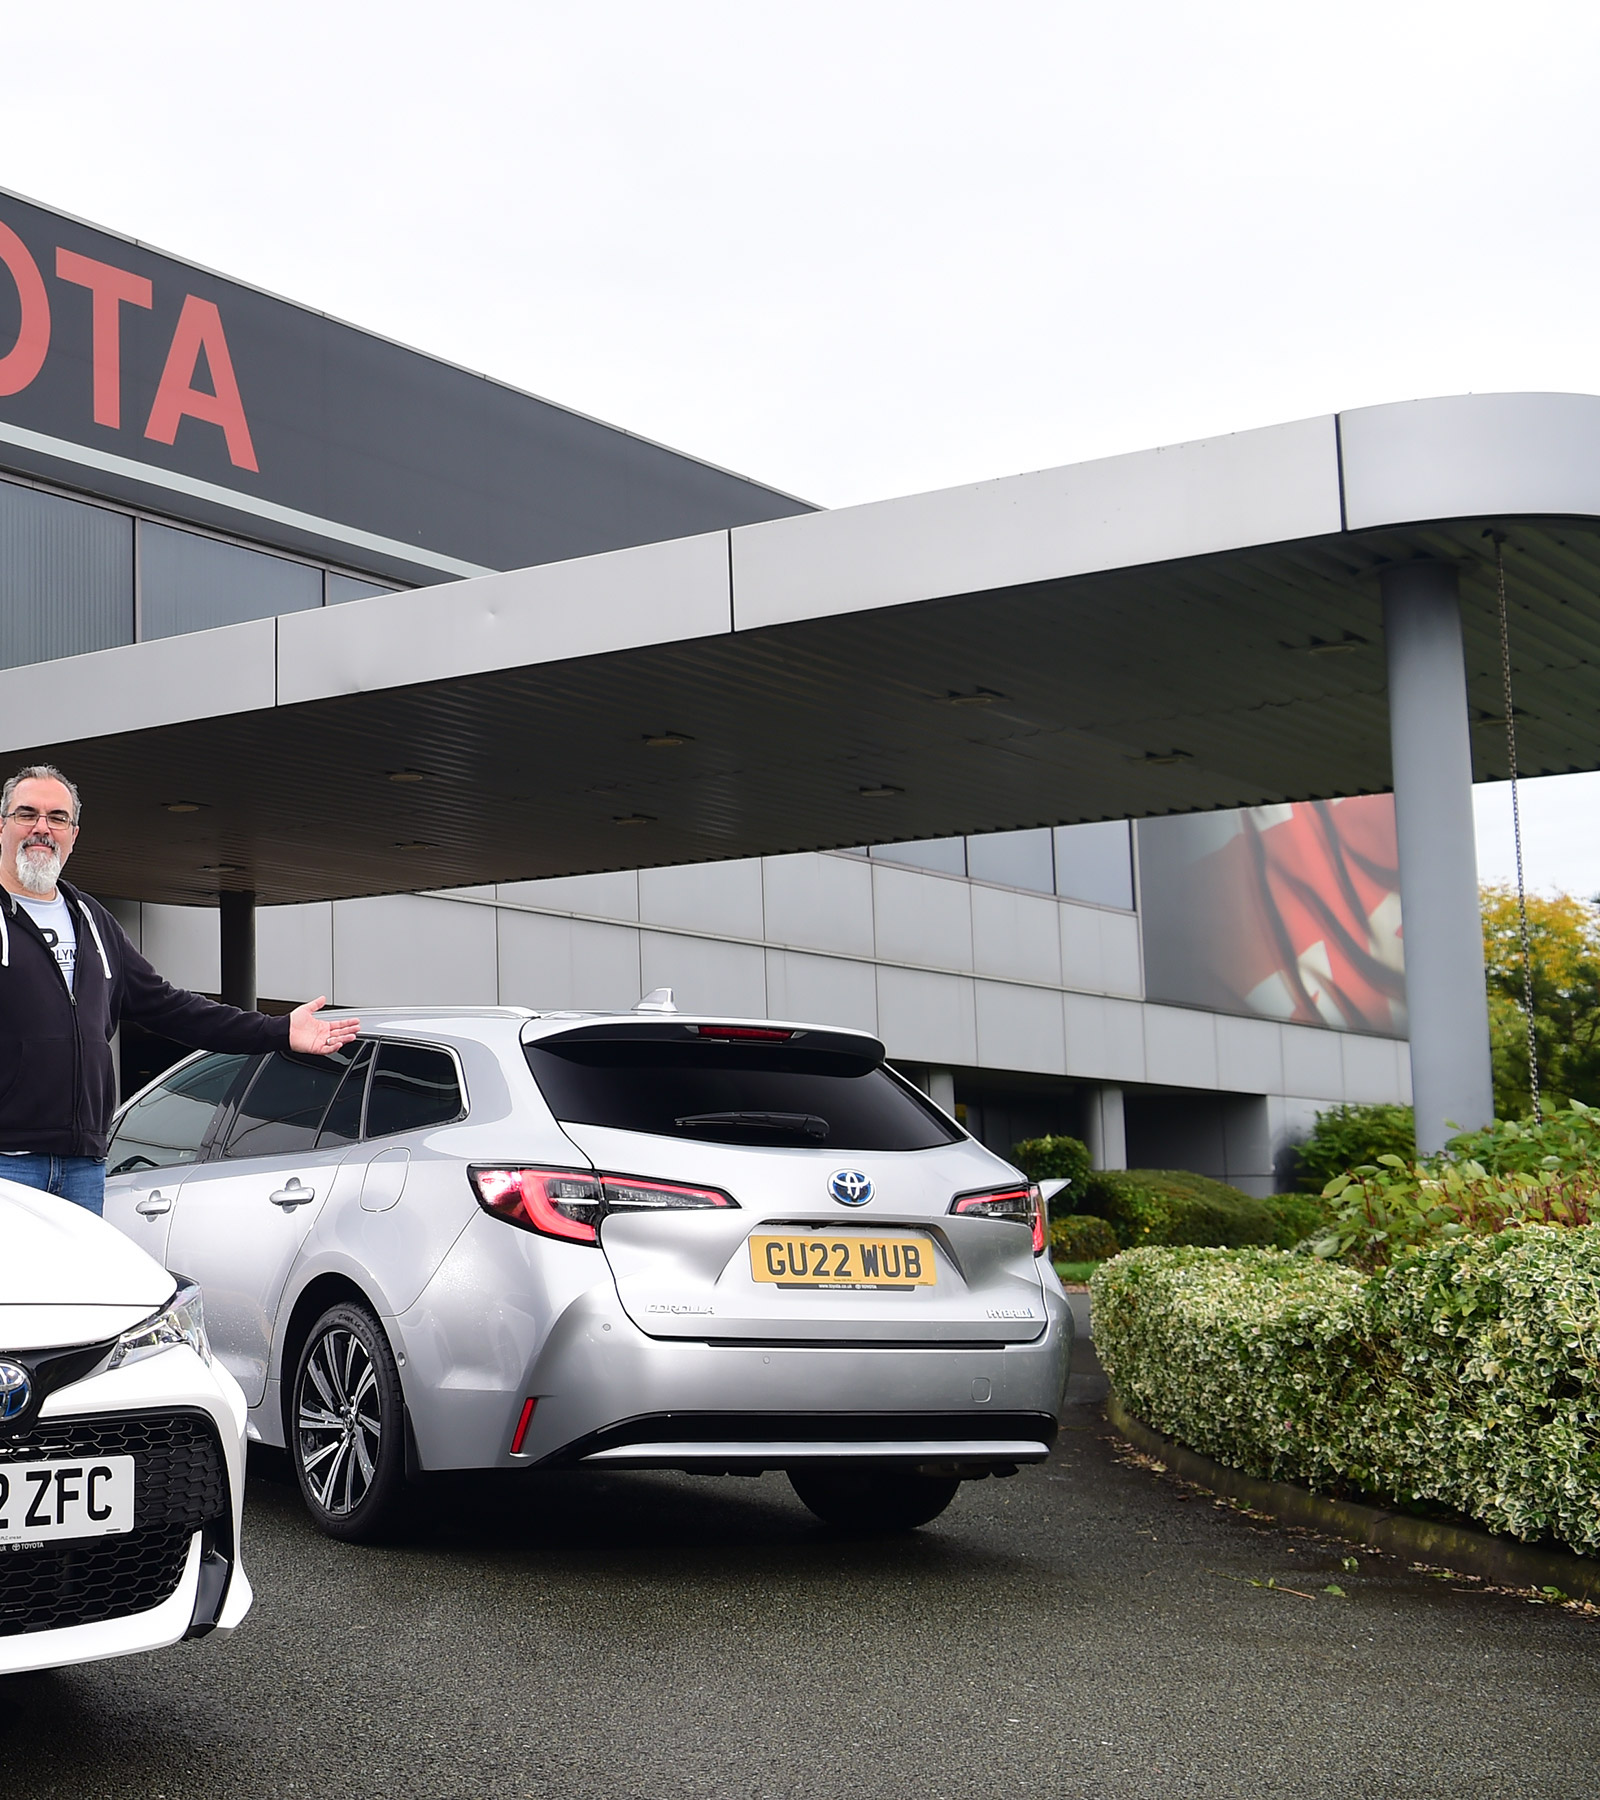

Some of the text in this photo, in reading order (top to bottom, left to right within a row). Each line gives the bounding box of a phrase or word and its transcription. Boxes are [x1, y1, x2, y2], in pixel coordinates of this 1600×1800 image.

[765, 1242, 922, 1278] GU22 WUB
[24, 1466, 113, 1527] ZFC
[21, 1541, 45, 1550] TOYOTA
